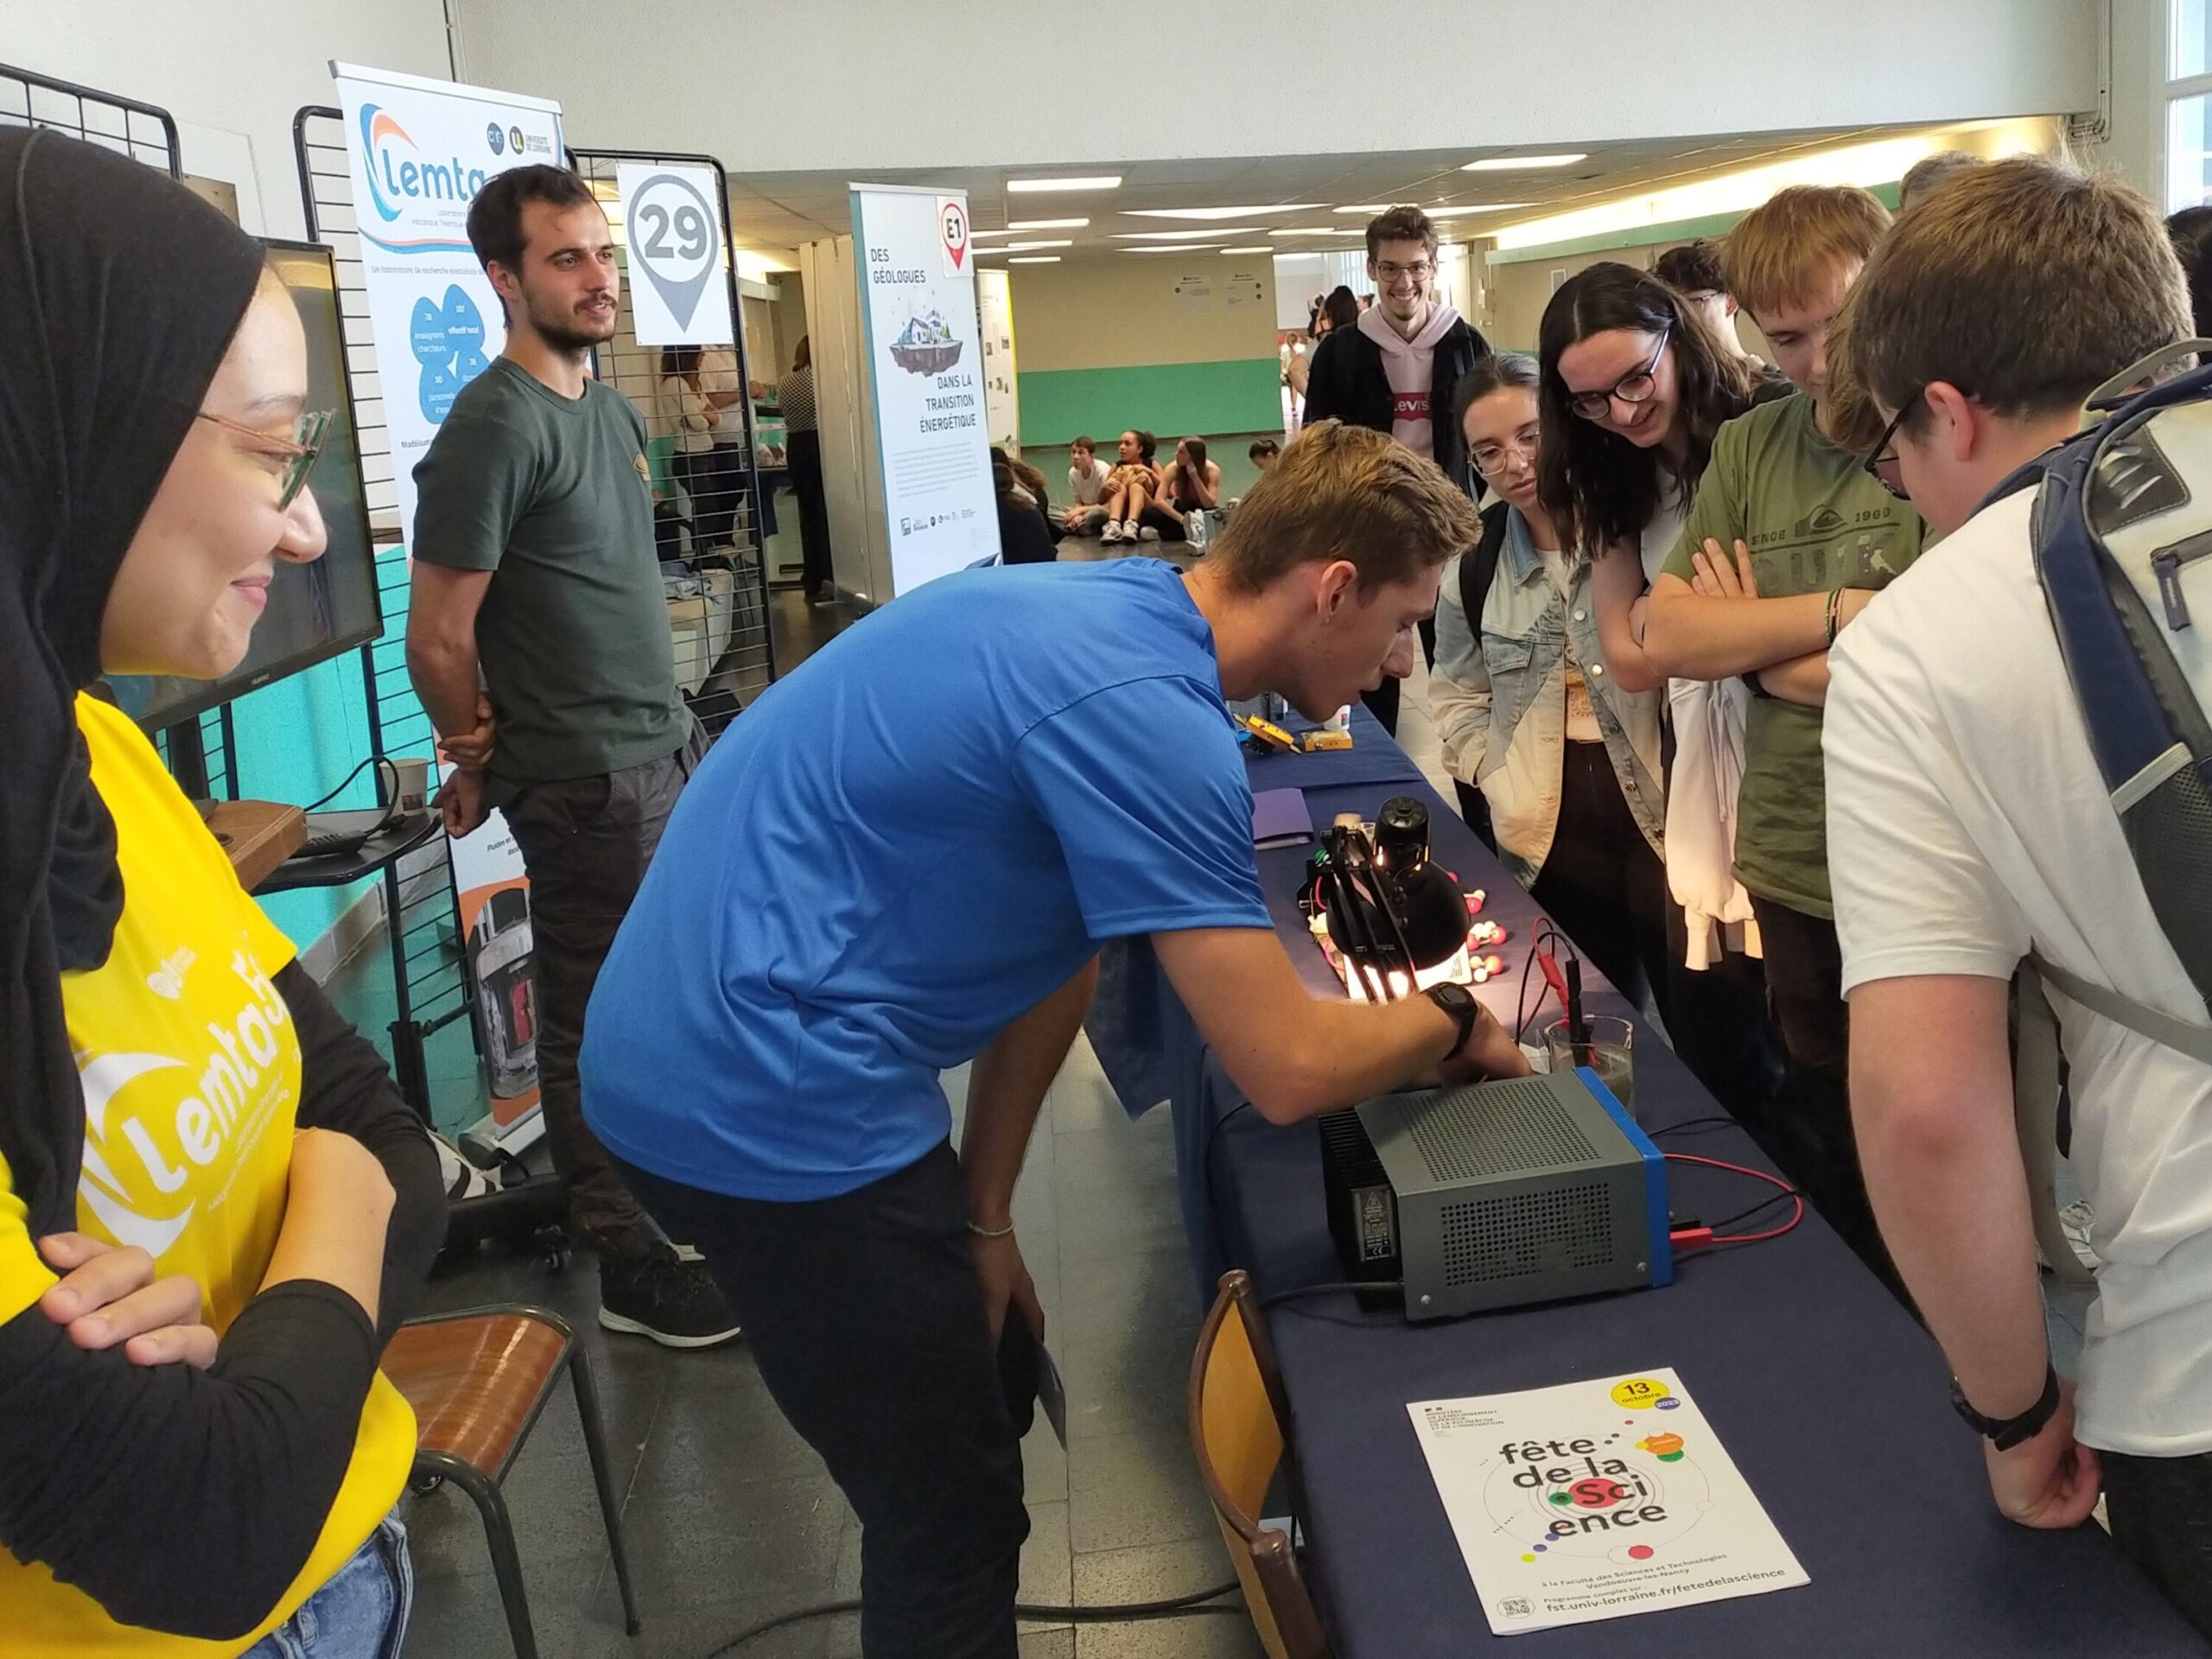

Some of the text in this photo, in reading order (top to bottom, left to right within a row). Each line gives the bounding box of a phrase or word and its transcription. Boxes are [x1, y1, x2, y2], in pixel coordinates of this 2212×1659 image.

[382, 149, 485, 202] lemta
[639, 204, 708, 260] 29
[946, 218, 962, 238] E1
[870, 248, 890, 262] DES
[381, 265, 413, 274] laboratoire
[873, 266, 926, 283] GÉOLOGUES
[937, 374, 973, 390] DANS LA
[925, 394, 975, 411] TRANSITION
[919, 413, 976, 433] ÉNERGÉTIQUE
[1622, 1392, 1662, 1403] octobre
[1623, 1382, 1649, 1395] 13
[1498, 1439, 1597, 1464] fête
[1513, 1457, 1629, 1488] de la
[1548, 1505, 1669, 1537] ence
[1560, 1577, 1593, 1586] Faculté
[1614, 1567, 1654, 1578] Sciences
[1667, 1554, 1727, 1568] Technologies
[1546, 1568, 1786, 1613] fst.univ-lorraine.fr/fetedelascience
[1592, 1588, 1628, 1599] complet
